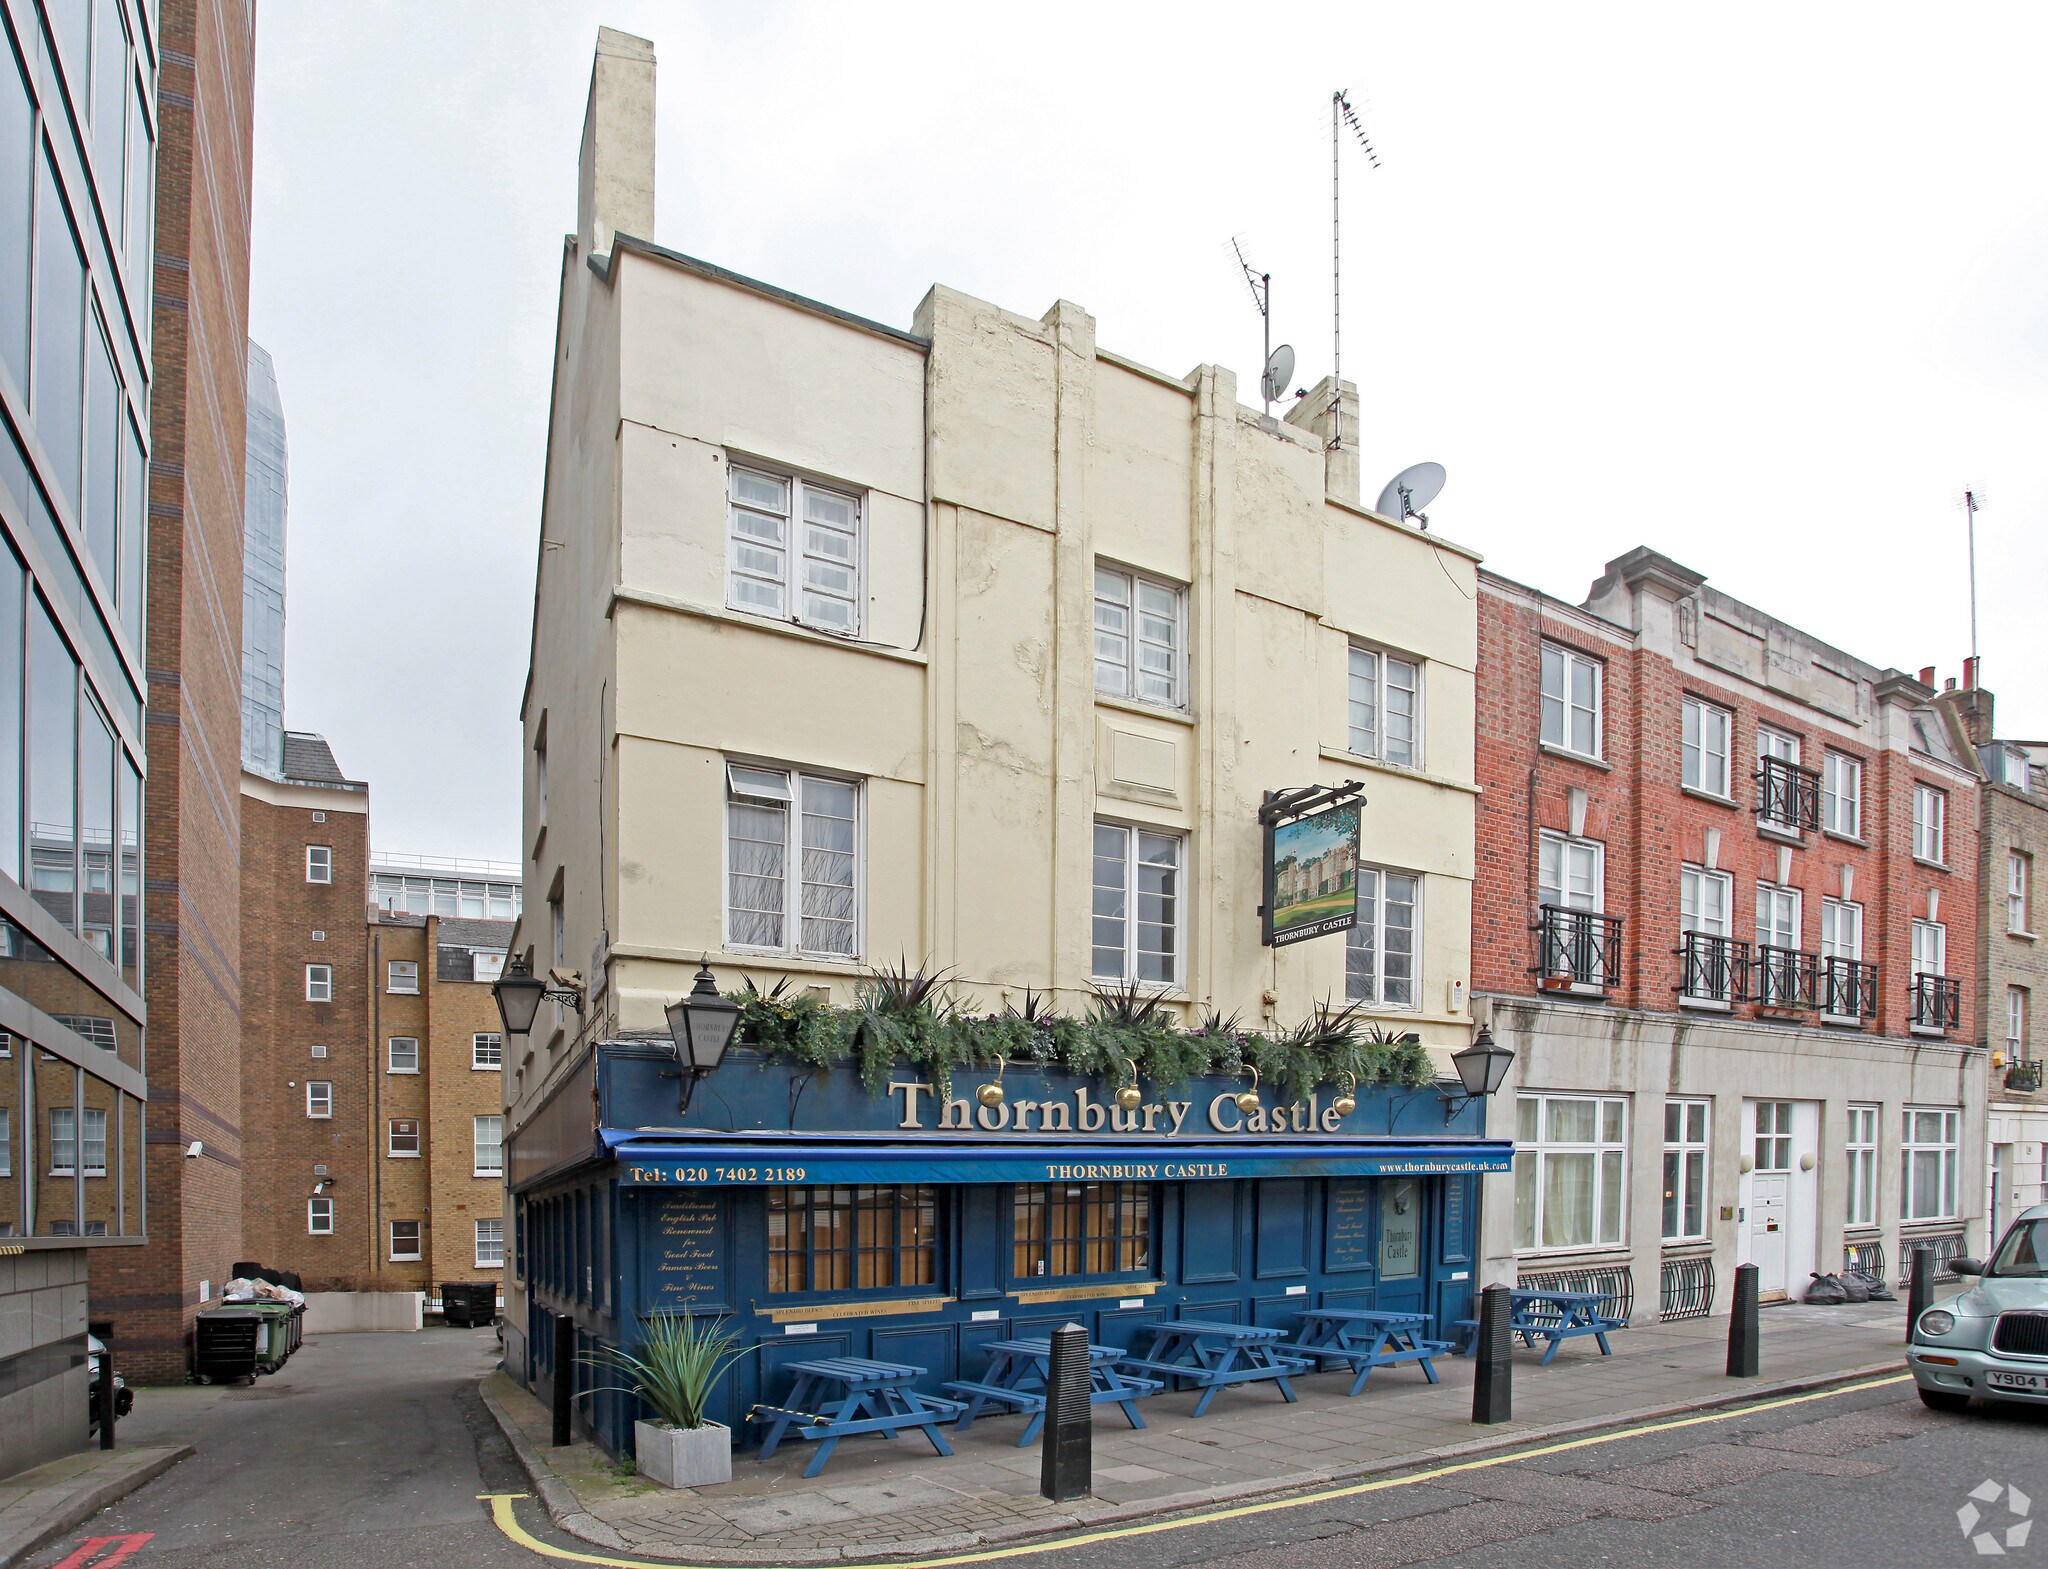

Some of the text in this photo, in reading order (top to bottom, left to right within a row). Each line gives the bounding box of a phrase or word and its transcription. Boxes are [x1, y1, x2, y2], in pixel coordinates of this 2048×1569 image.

[1275, 916, 1352, 943] THORNBURY CASTLE
[887, 1081, 1342, 1138] Thornbury Castle
[1046, 1163, 1228, 1179] THORNBURY CASTLE
[1379, 1161, 1508, 1174] www.thornburycastle.uk.com
[630, 1168, 806, 1182] Tel: 020 7402 2189
[661, 1201, 717, 1210] Traditional
[660, 1213, 718, 1225] English Pub
[662, 1226, 714, 1235] Renowned
[1386, 1229, 1413, 1245] Thornbury
[682, 1238, 696, 1248] for
[663, 1249, 714, 1259] Good Food
[1387, 1245, 1409, 1259] Castle
[657, 1262, 719, 1272] Famous Beers
[661, 1282, 714, 1292] Fine Wines
[1992, 1372, 2038, 1387] Y904
